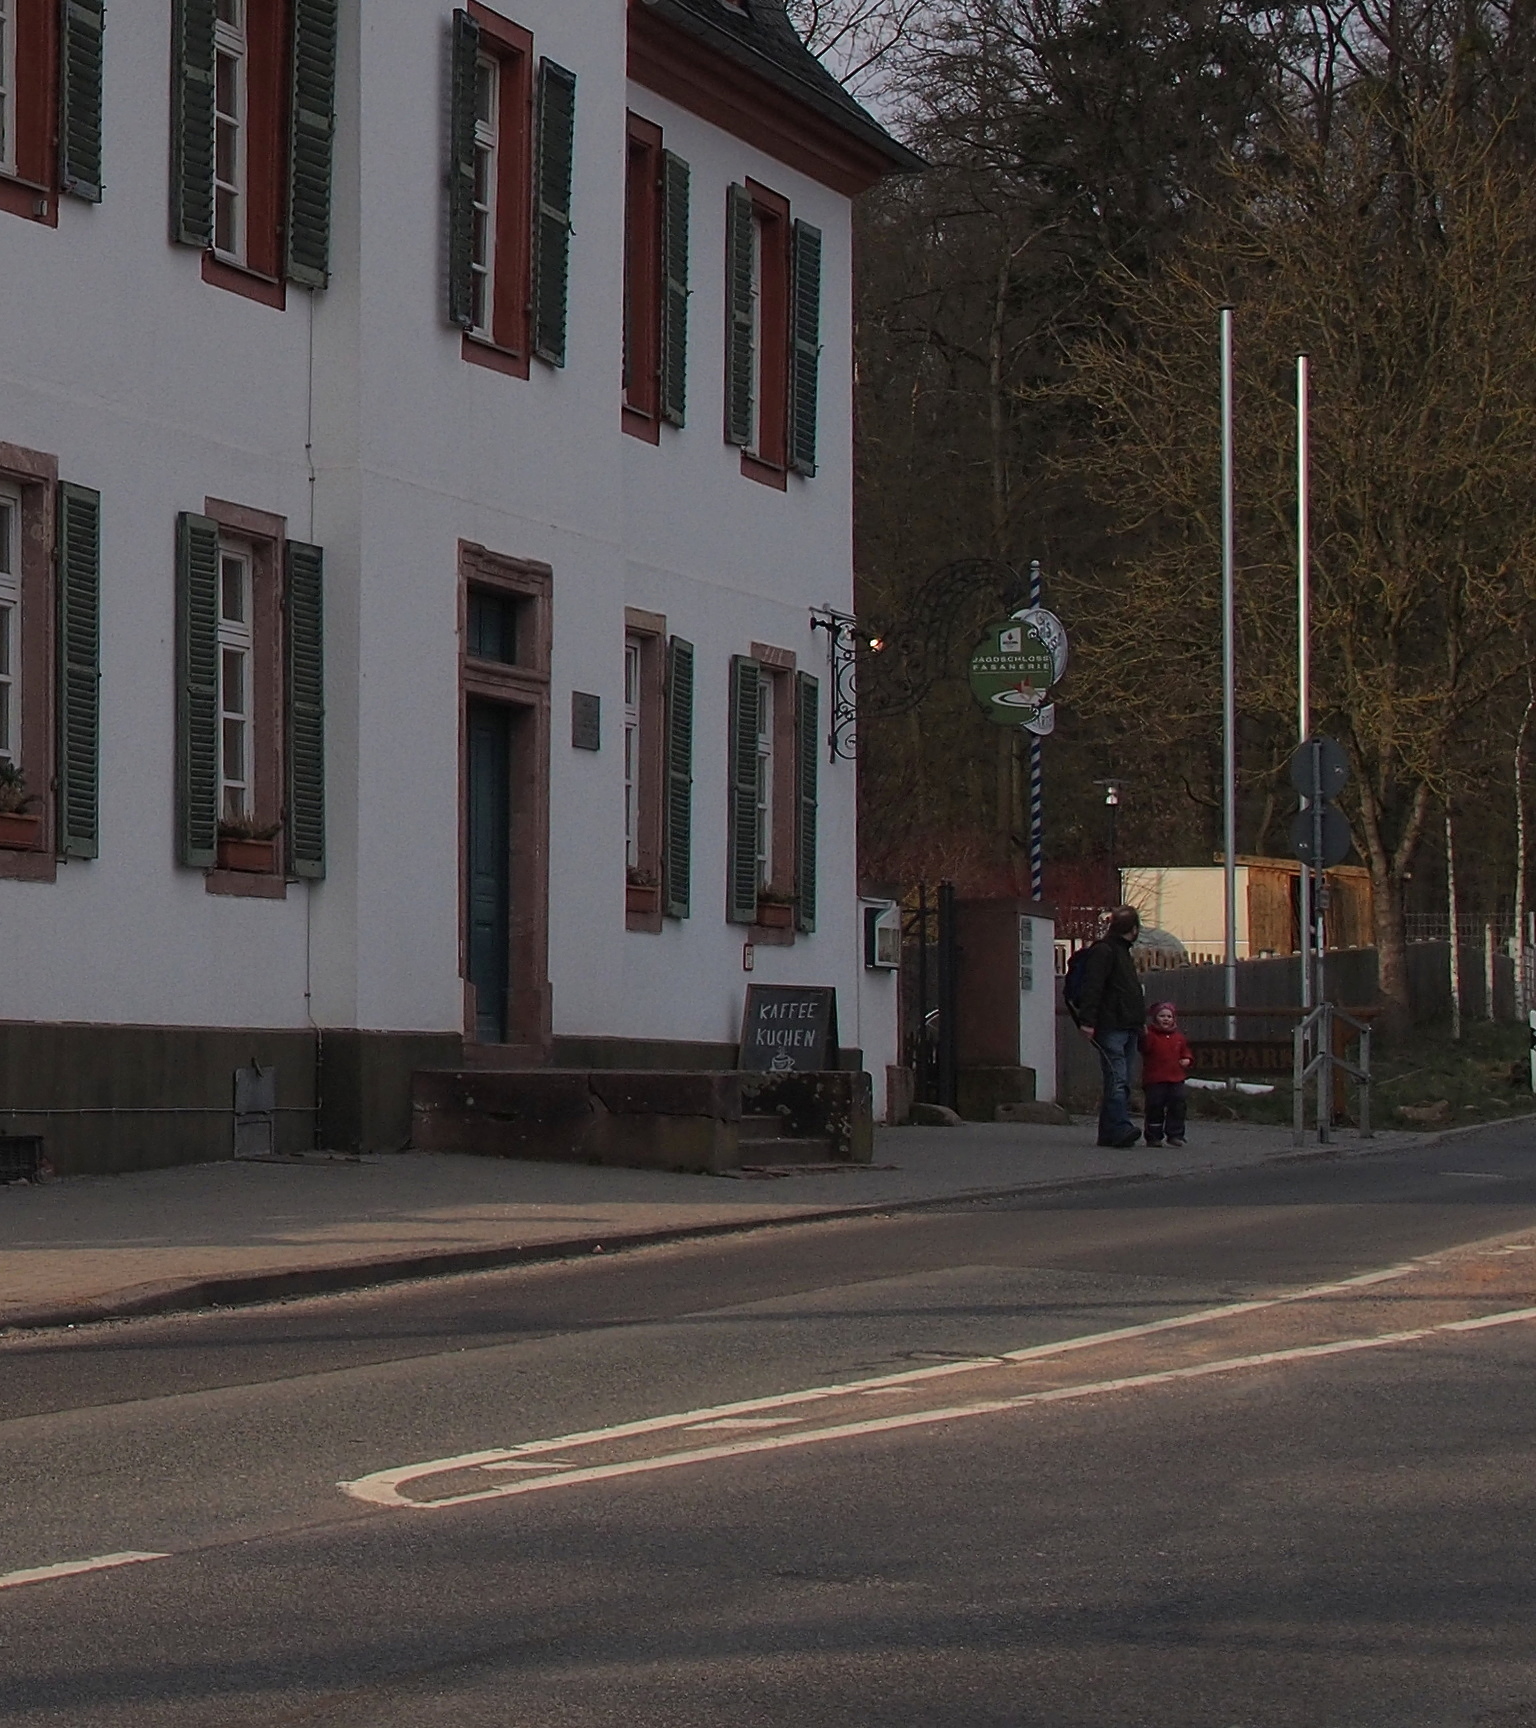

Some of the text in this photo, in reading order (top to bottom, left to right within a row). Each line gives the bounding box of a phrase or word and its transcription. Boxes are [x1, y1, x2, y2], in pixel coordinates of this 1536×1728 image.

[972, 655, 1050, 663] JAGDSCHLOSS
[972, 662, 1049, 671] FASANERIE
[759, 1002, 819, 1020] KAFFEE
[755, 1028, 816, 1047] KUCHEN
